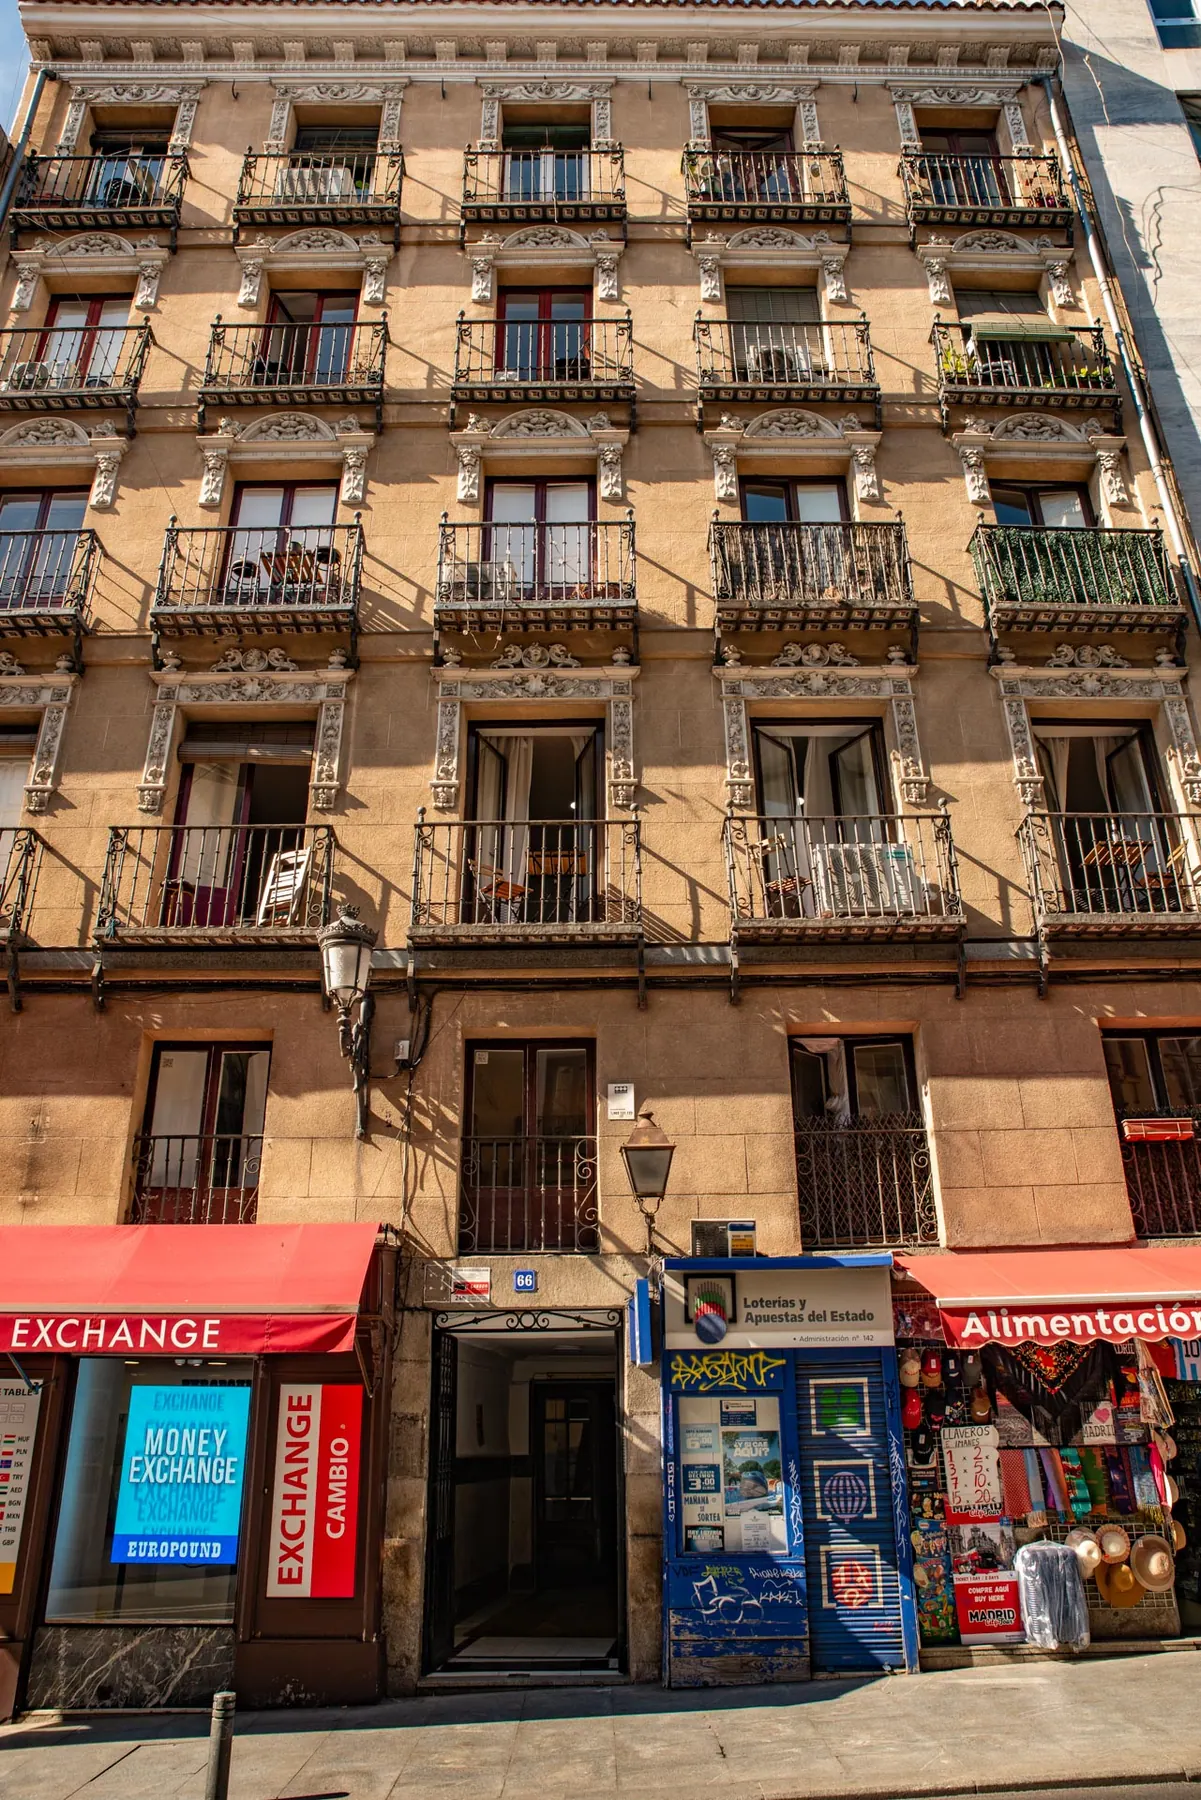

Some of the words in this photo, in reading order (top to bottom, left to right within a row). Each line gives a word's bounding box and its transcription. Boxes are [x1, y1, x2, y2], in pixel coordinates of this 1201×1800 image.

[516, 1274, 533, 1287] 66
[743, 1296, 796, 1309] Loterías
[798, 1299, 807, 1311] y
[744, 1312, 805, 1326] Apuestas
[807, 1310, 827, 1323] del
[830, 1309, 875, 1322] Estado
[11, 1318, 221, 1349] EXCHANGE
[799, 1334, 850, 1343] Administración
[863, 1334, 874, 1342] 142
[1182, 1340, 1200, 1357] 10
[3, 1388, 33, 1396] TABLE
[154, 1391, 226, 1412] EXCHANGE
[943, 1426, 990, 1440] LLAVEROS
[144, 1428, 228, 1456] MONEY
[955, 1437, 980, 1448] IMANES
[946, 1450, 954, 1462] 1
[973, 1446, 983, 1460] 2
[128, 1456, 238, 1484] EXCHANGE
[949, 1463, 957, 1476] 3
[974, 1461, 983, 1474] 5
[277, 1394, 312, 1585] EXCHANGE
[326, 1437, 350, 1540] CAMBIO
[951, 1477, 959, 1490] 7
[974, 1474, 987, 1488] 10
[684, 1495, 709, 1505] MAÑANA
[952, 1491, 962, 1505] 15
[974, 1489, 991, 1504] 20
[136, 1501, 219, 1523] EXCHANGE
[697, 1513, 721, 1522] SORTEA
[127, 1541, 222, 1558] EUROPOUND
[968, 1586, 993, 1594] COMPRE
[995, 1584, 1010, 1593] AQUÍ
[974, 1595, 986, 1603] BUY
[988, 1594, 1005, 1602] HERE
[968, 1609, 1015, 1623] MADRID
